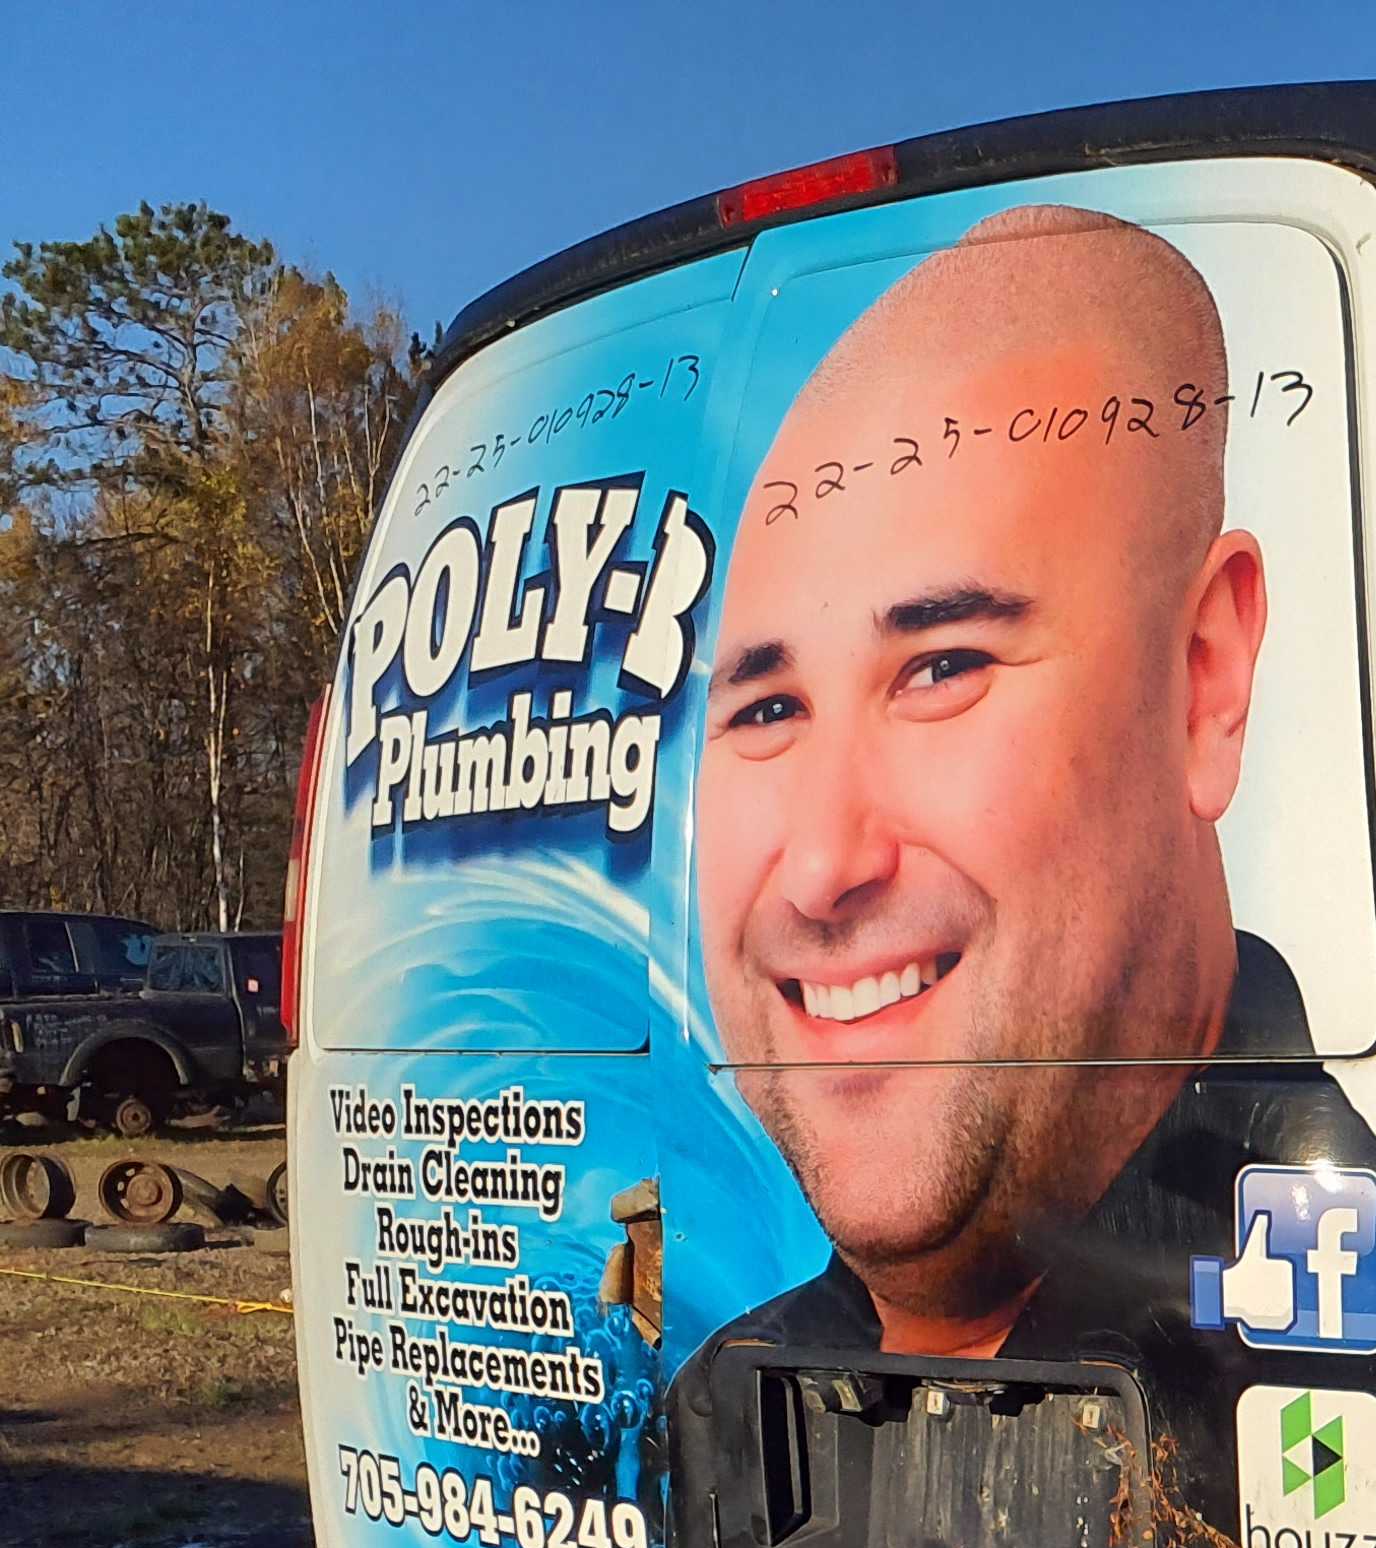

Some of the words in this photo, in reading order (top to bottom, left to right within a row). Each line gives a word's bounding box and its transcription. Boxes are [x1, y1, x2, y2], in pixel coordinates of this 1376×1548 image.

[371, 689, 662, 834] Plumbing
[328, 1087, 396, 1135] Video
[402, 1086, 584, 1148] Inspections
[342, 1147, 414, 1192] Drain
[422, 1149, 562, 1216] Cleaning
[376, 1207, 518, 1268] Rough-ins
[345, 1262, 393, 1311] Full
[399, 1267, 571, 1332] Excavation
[334, 1317, 385, 1375] Pipe
[389, 1326, 601, 1398] Replacements
[407, 1384, 428, 1431] &
[433, 1390, 540, 1456] More...
